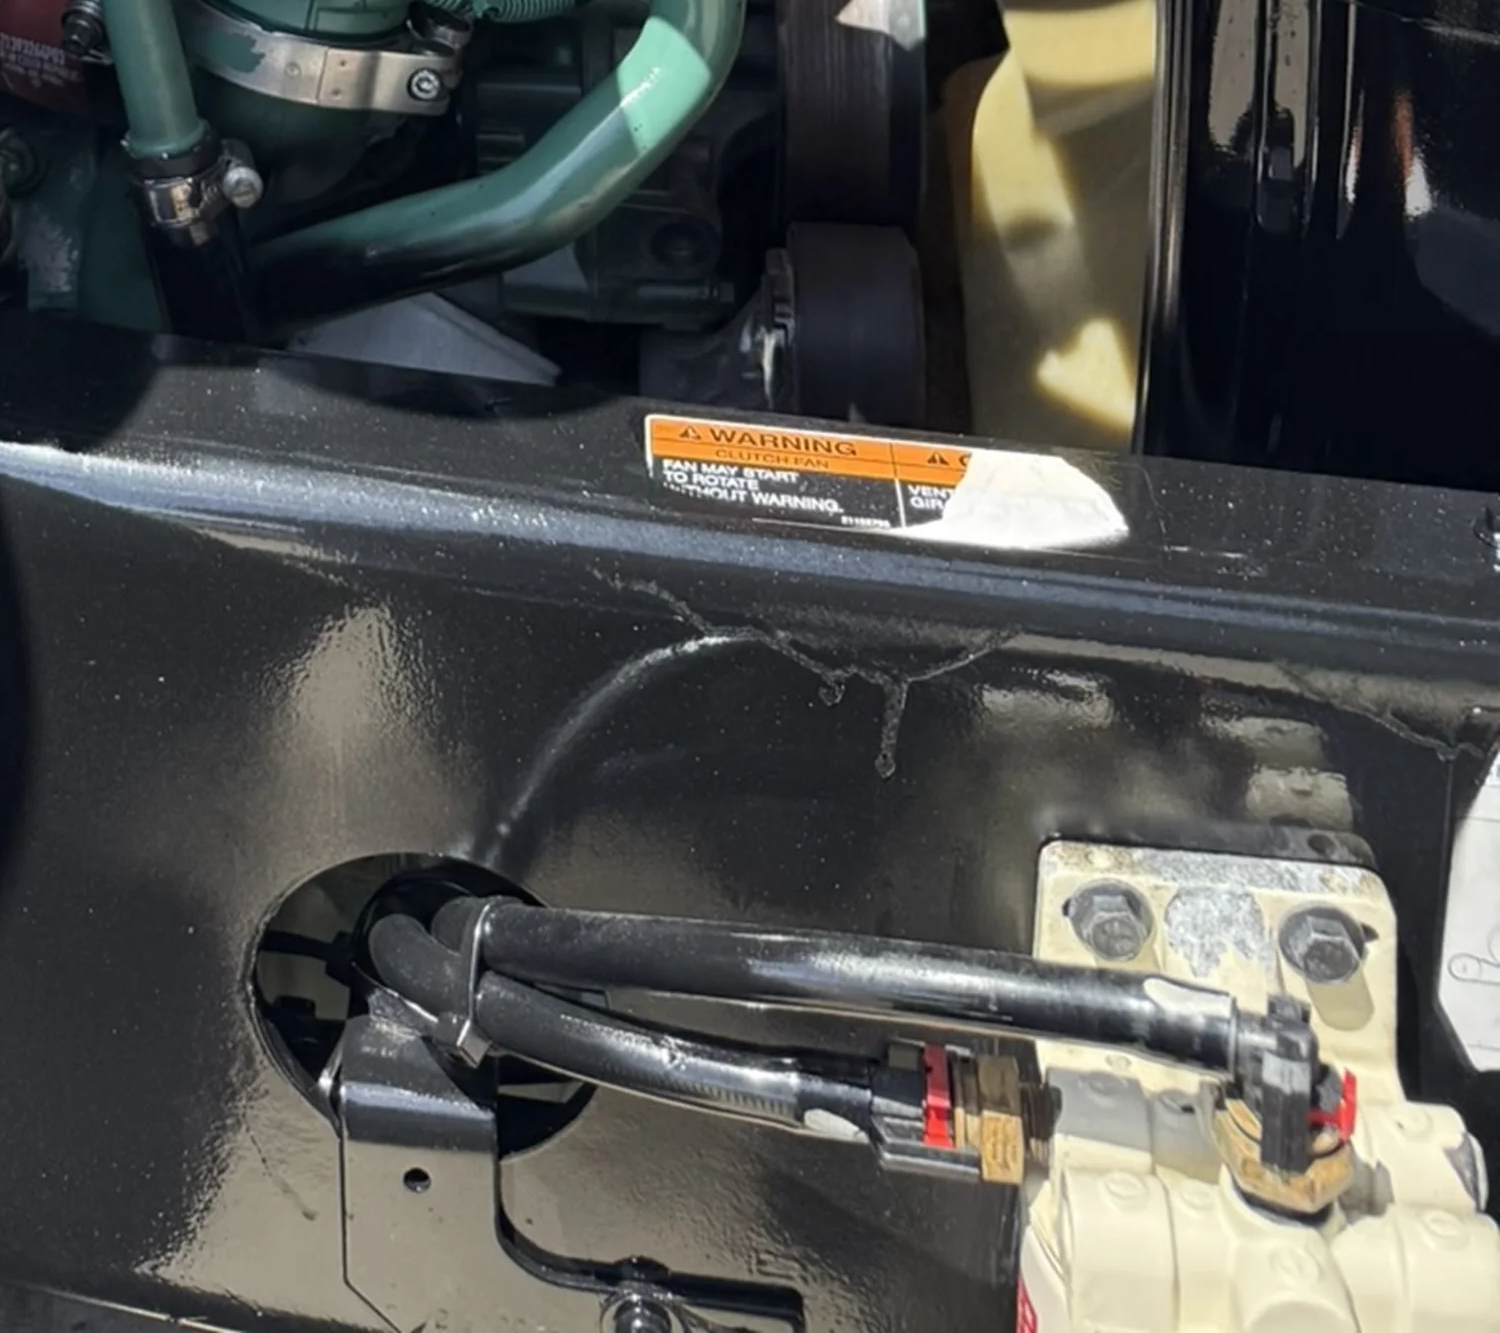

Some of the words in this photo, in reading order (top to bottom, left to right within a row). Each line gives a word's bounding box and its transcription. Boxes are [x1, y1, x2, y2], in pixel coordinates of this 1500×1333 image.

[709, 428, 857, 456] WARNING
[716, 448, 788, 464] CLUTCH
[794, 457, 829, 469] FAN
[662, 459, 698, 472] FAN
[701, 463, 738, 476] MAY
[743, 466, 799, 483] START
[663, 470, 688, 484] TO
[692, 472, 759, 491] ROTATE
[663, 481, 747, 502] THOUT
[751, 491, 844, 513] WARNING.
